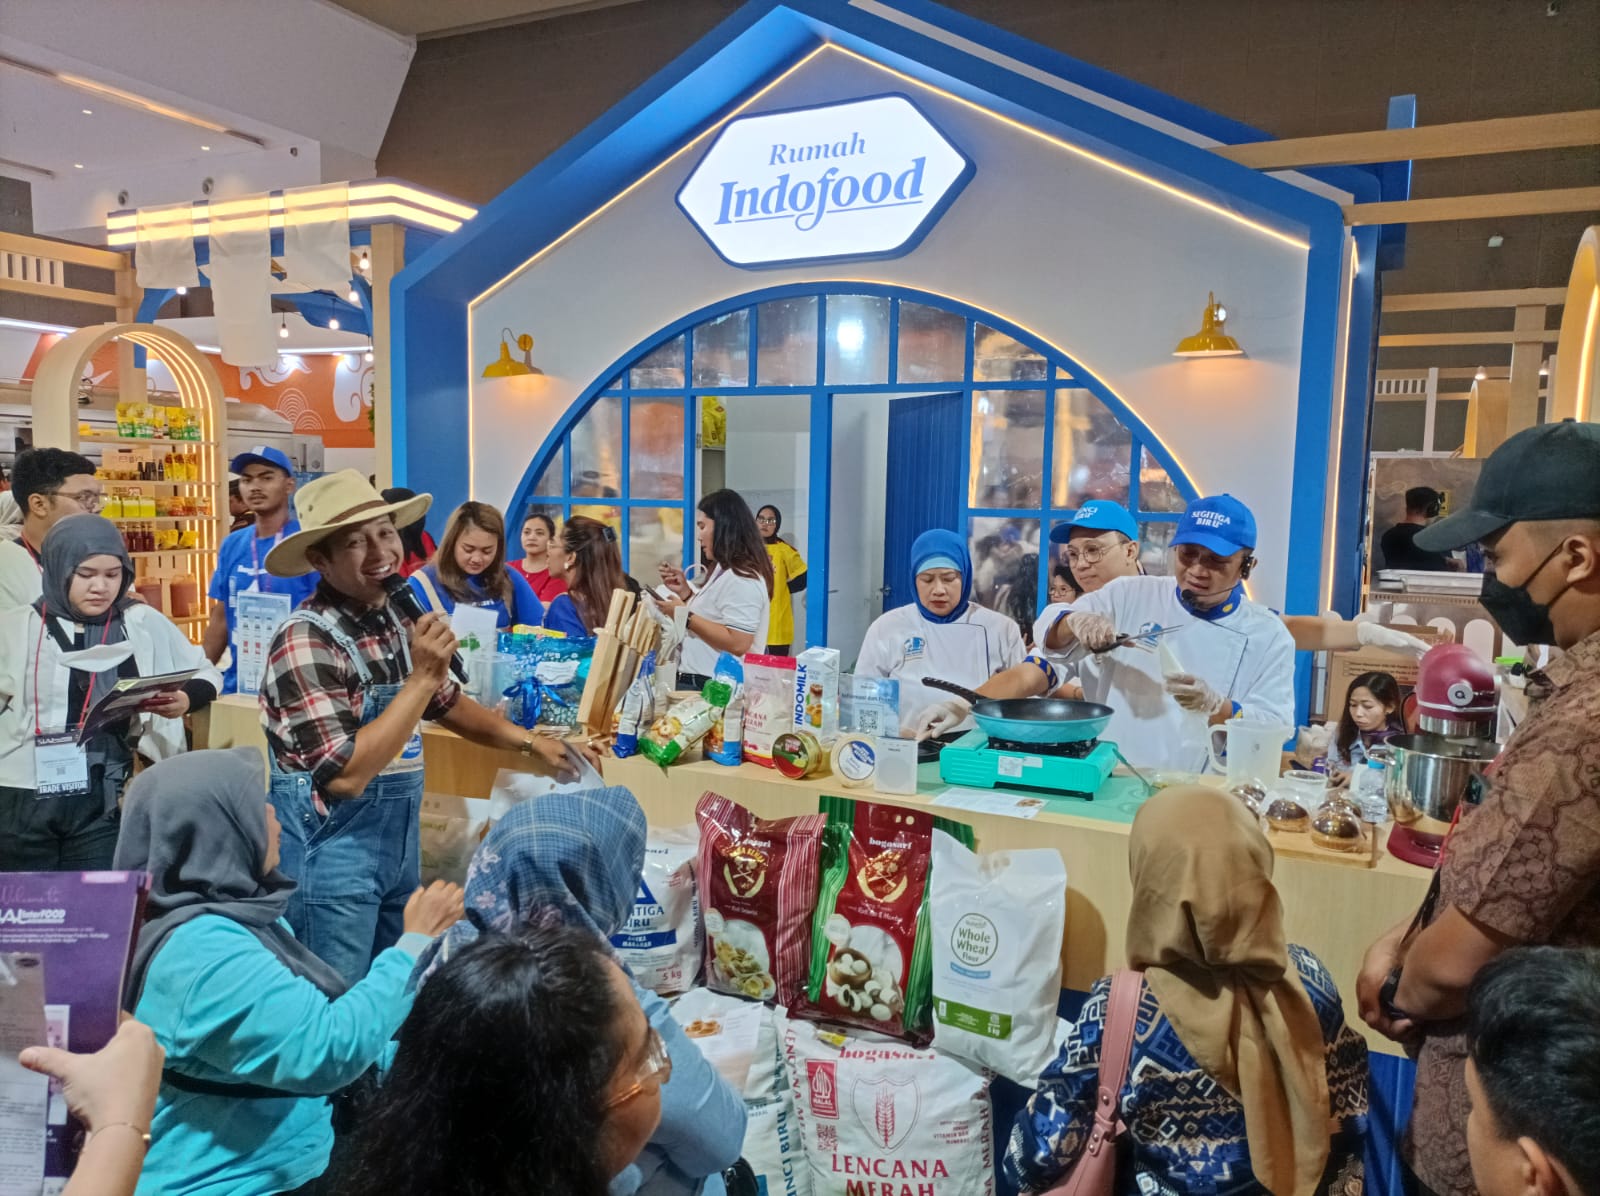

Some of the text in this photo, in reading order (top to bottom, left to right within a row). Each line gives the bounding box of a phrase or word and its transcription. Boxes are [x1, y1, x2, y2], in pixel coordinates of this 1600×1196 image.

[769, 132, 866, 165] Rumah
[714, 156, 927, 231] Indofood
[1191, 510, 1231, 525] SEGITIGA
[1196, 518, 1220, 529] BIRU
[795, 664, 807, 726] INDOMILK
[40, 785, 61, 794] TRADE
[631, 905, 665, 917] TIGA
[958, 927, 991, 943] Whole
[957, 938, 989, 956] Wheat
[662, 973, 668, 981] 5
[671, 968, 682, 979] kg
[838, 1046, 935, 1063] bogasa
[777, 1111, 790, 1154] BIRU
[832, 1153, 949, 1178] LENCANA
[782, 1160, 797, 1196] UNCI
[846, 1179, 935, 1196] MERAH
